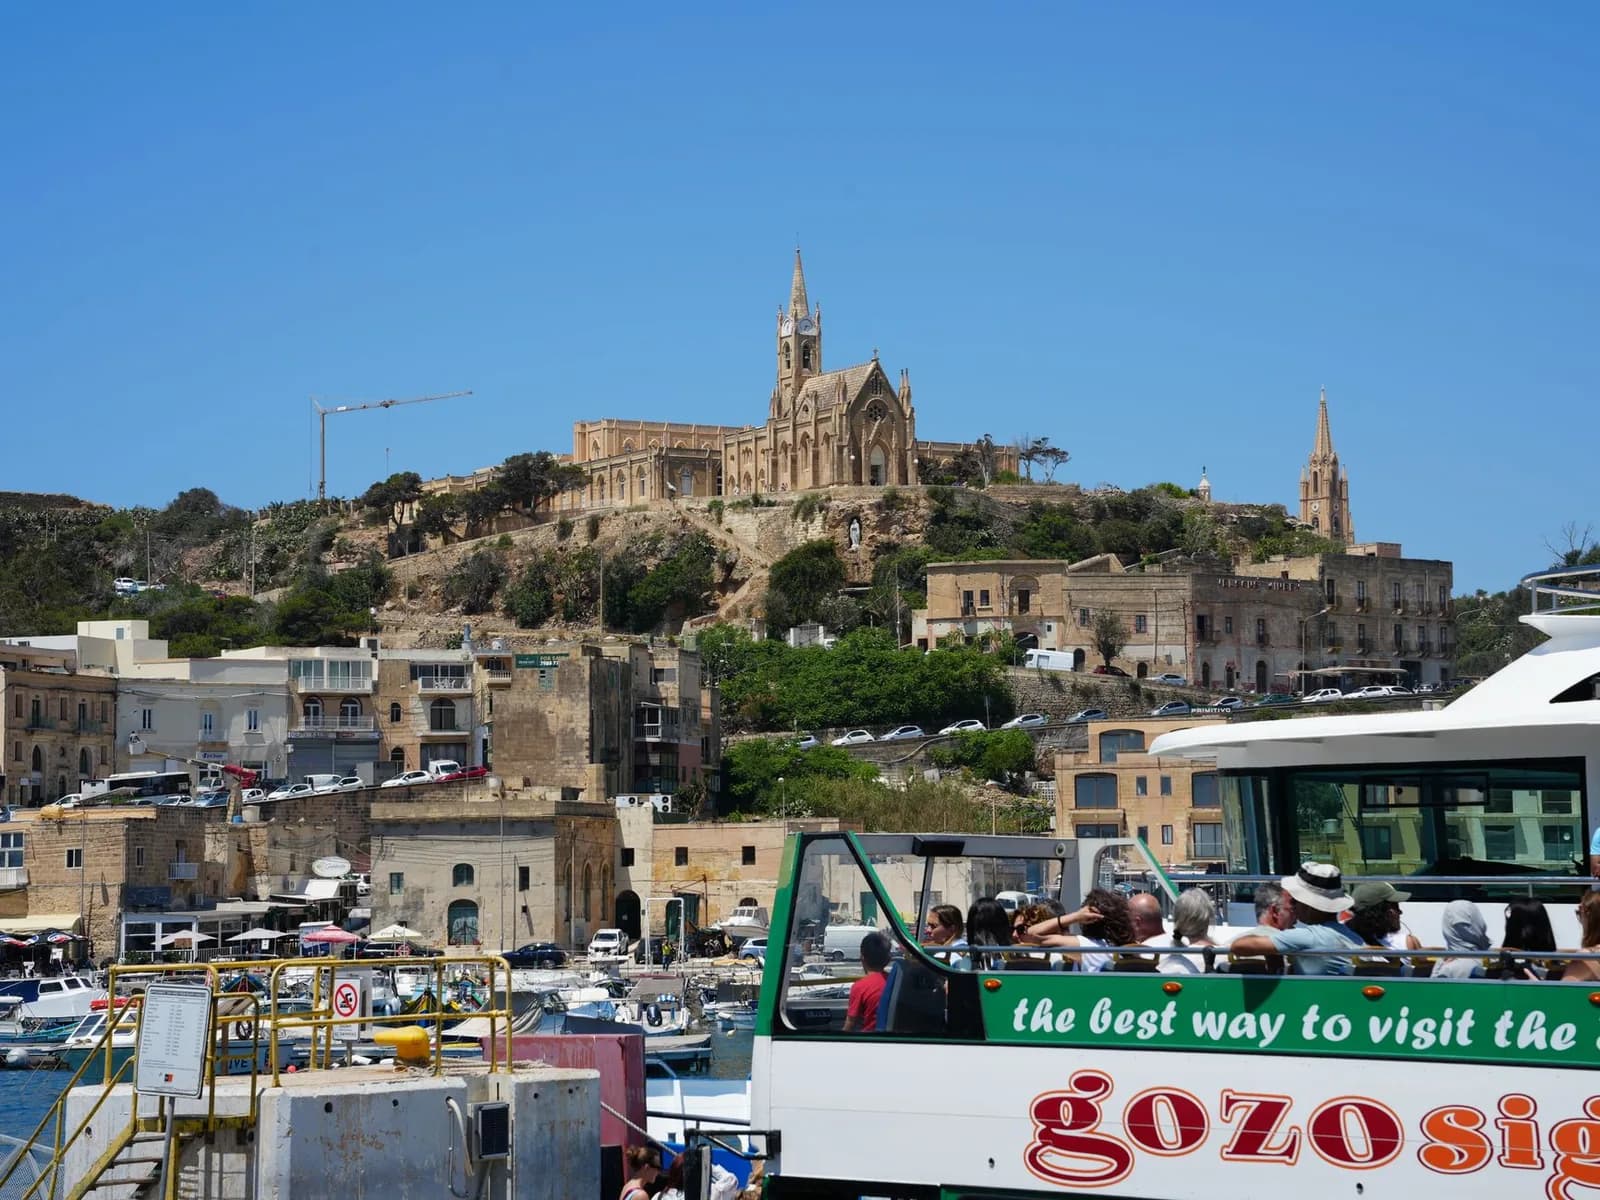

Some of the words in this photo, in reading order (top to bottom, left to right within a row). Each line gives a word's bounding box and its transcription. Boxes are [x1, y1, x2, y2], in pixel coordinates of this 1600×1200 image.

[1013, 997, 1075, 1033] the
[1089, 997, 1177, 1040] best
[1192, 1011, 1286, 1048] way
[1302, 1004, 1352, 1041] to
[1369, 1006, 1475, 1050] visit
[1494, 1010, 1577, 1051] the
